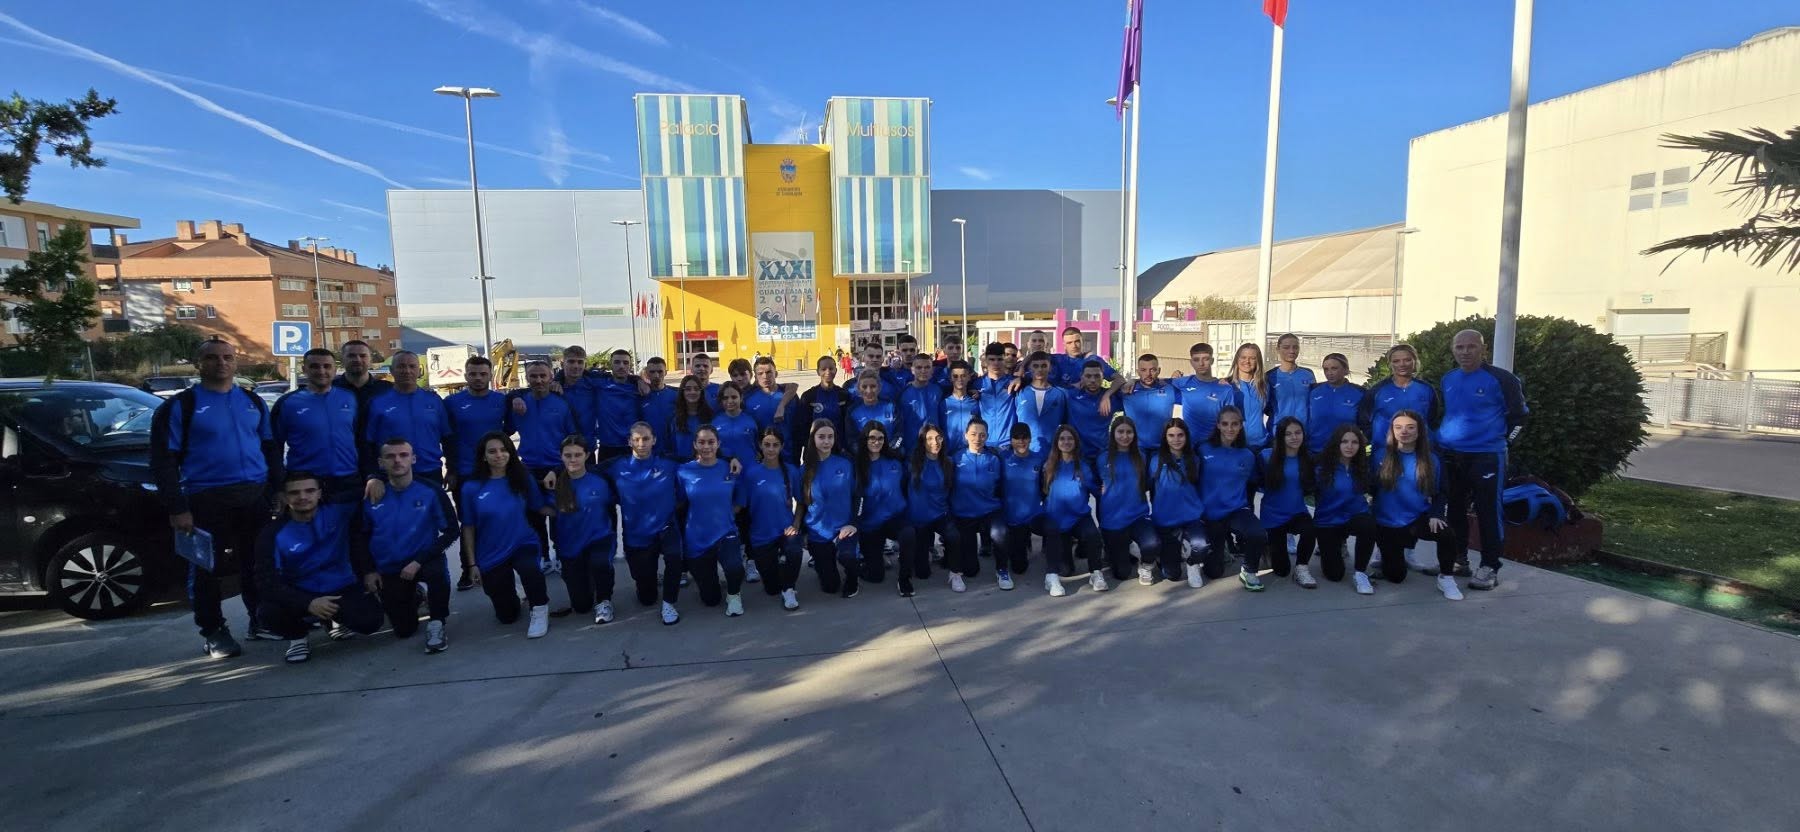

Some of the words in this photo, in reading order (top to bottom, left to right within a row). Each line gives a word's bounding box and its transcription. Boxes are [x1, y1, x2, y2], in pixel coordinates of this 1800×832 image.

[660, 120, 719, 136] Palacio
[847, 121, 915, 137] Multiusos
[759, 260, 812, 280] XXXI
[279, 325, 303, 352] P
